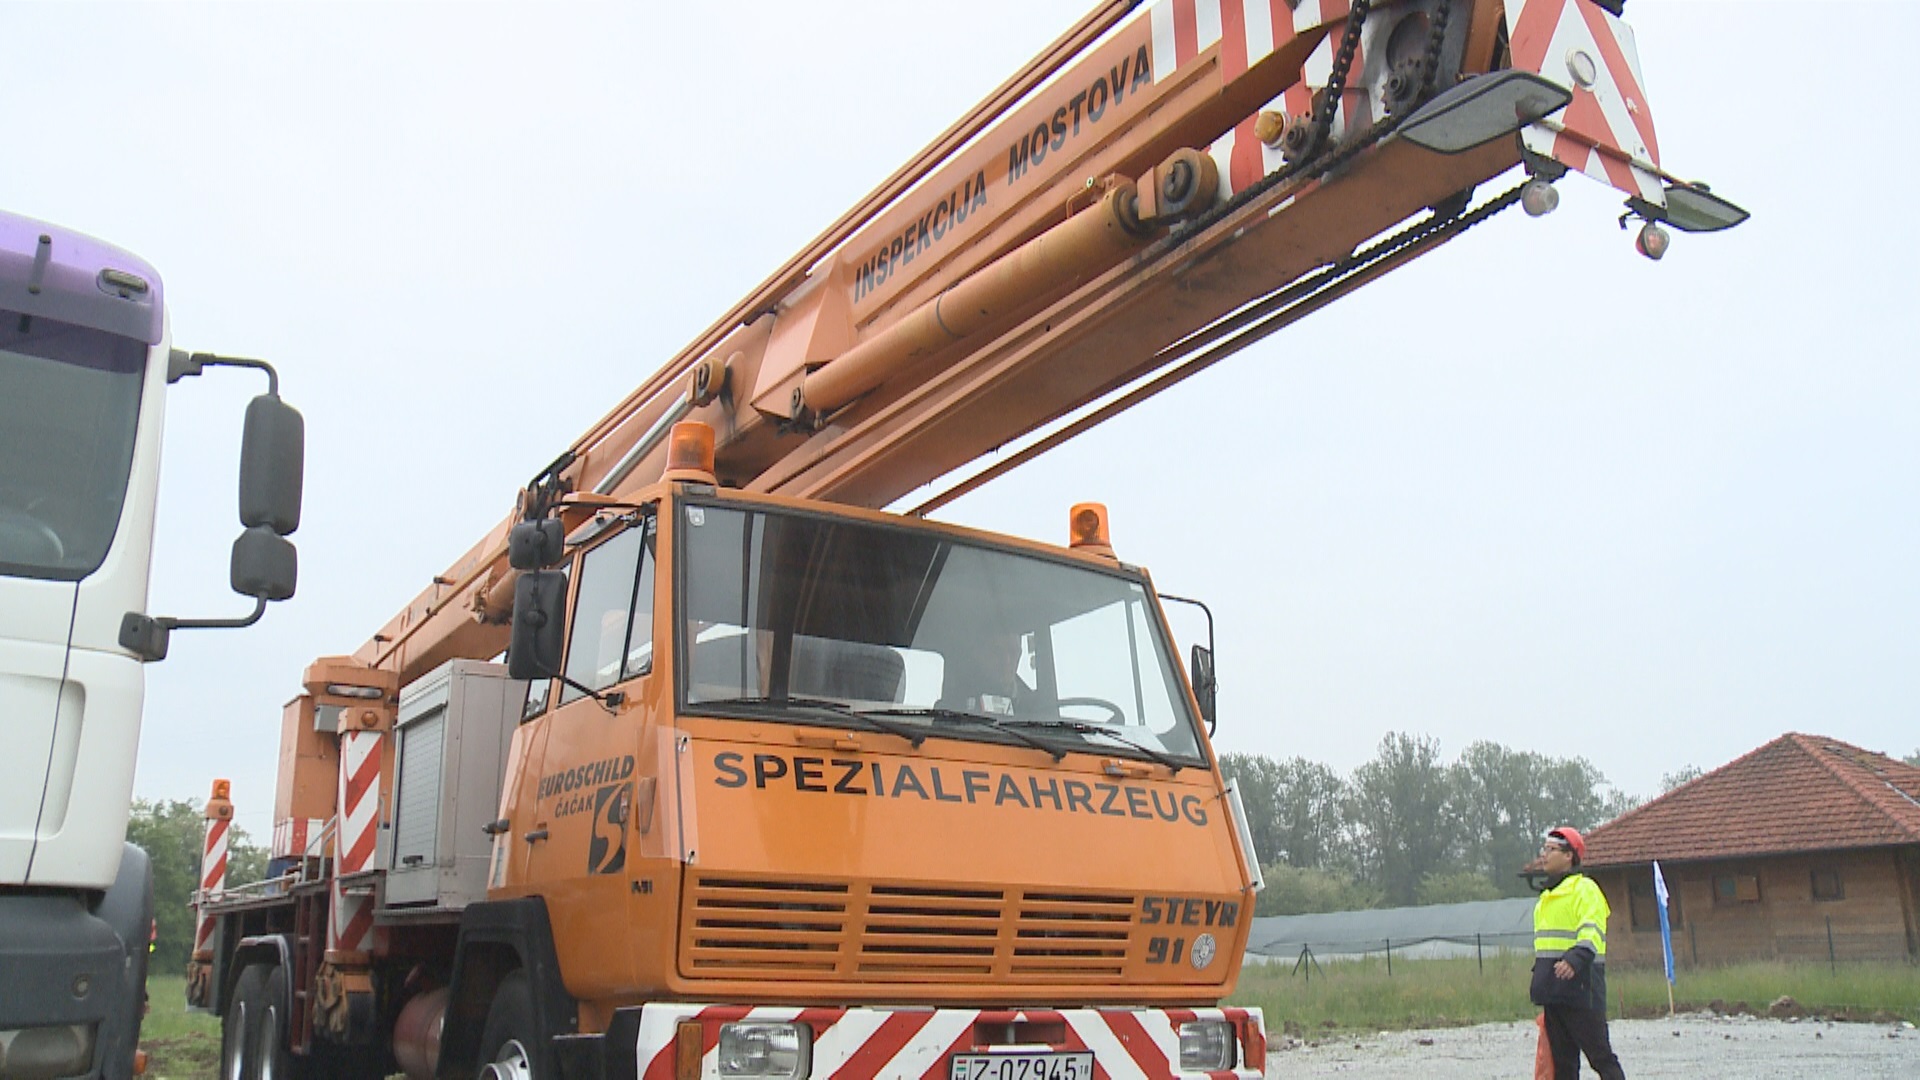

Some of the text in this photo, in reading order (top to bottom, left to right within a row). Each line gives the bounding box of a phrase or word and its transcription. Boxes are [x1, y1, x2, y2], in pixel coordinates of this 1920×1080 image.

[854, 44, 1151, 304] INSPEKCIJA MOSTOVA
[713, 751, 1208, 826] SPEZIALFAHRZEUG
[1140, 897, 1239, 927] STEYR
[1145, 937, 1185, 964] 91
